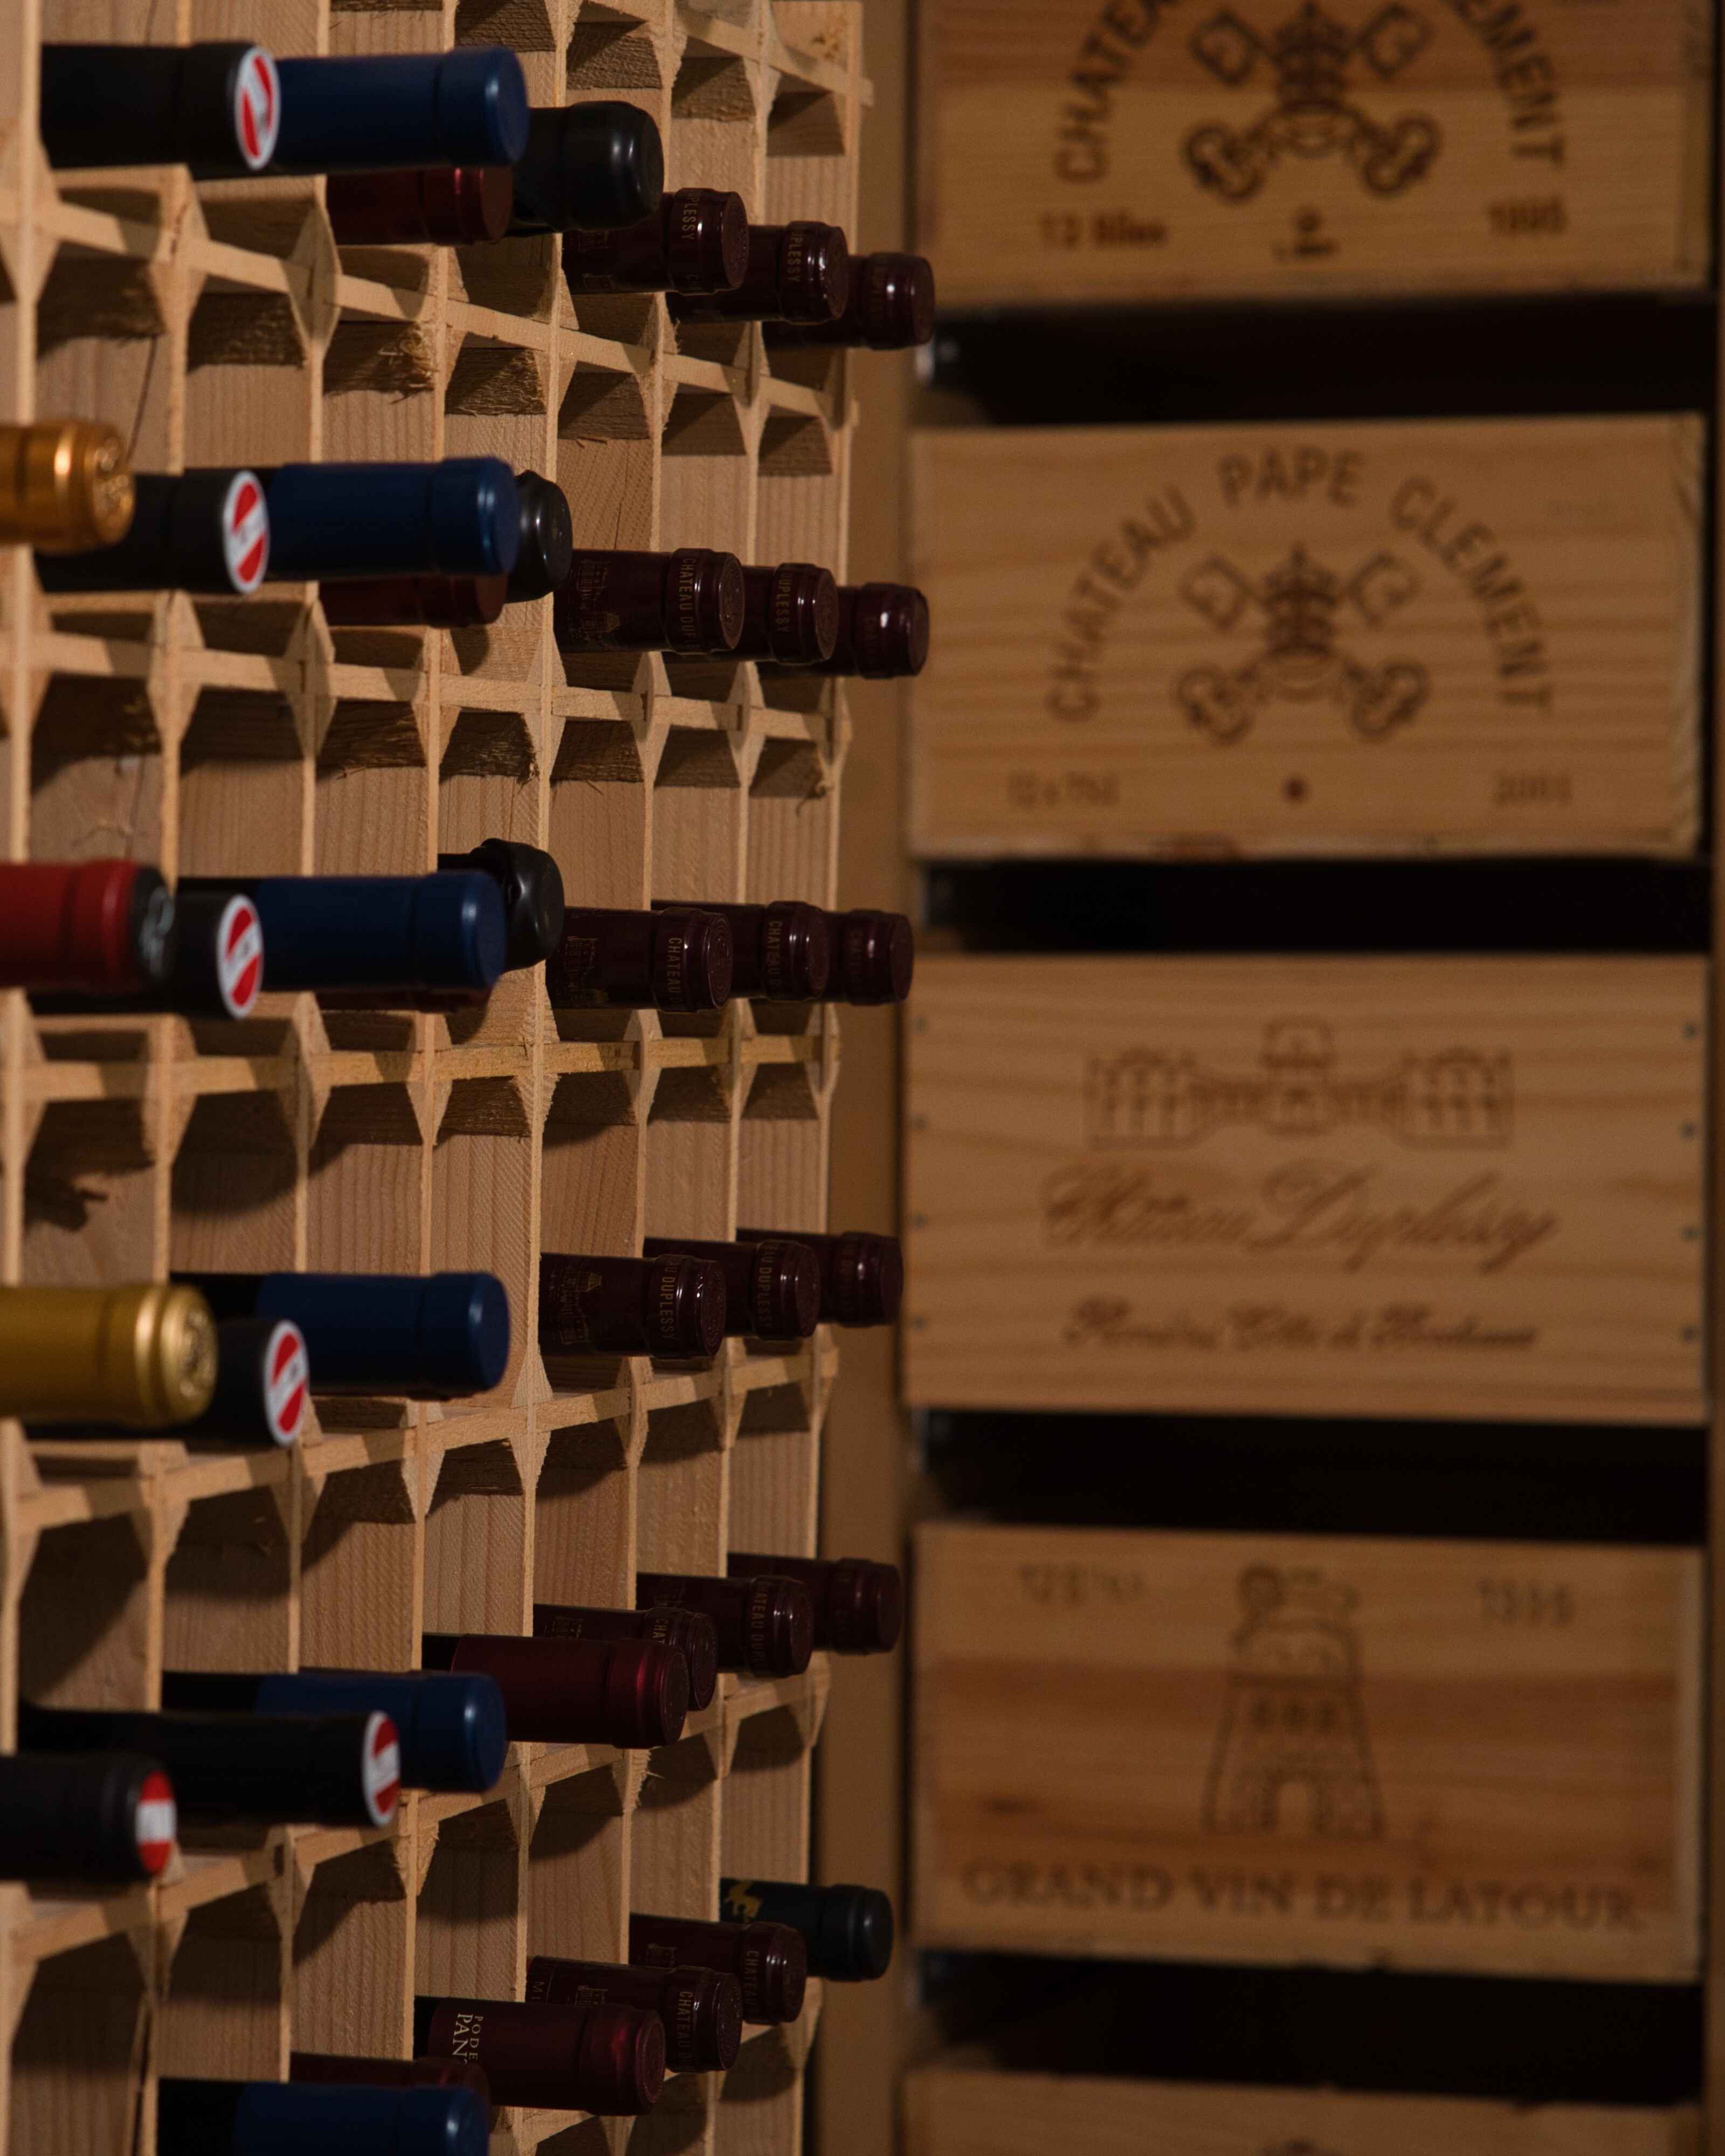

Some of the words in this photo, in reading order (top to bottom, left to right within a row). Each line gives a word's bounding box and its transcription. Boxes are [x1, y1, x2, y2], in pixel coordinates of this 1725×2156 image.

[1052, 0, 1163, 183] CHATE
[681, 190, 700, 241] UPLESSY
[678, 558, 696, 611] CHATEAU
[1044, 481, 1197, 724] CHATEAU
[1215, 443, 1365, 510] PAPE
[1388, 474, 1555, 716] CLEMENT
[666, 936, 684, 993] CHATEAU
[659, 1275, 678, 1342] DUPLESSY
[961, 1856, 1175, 1912] GRAND
[1186, 1867, 1295, 1918] VIN
[1312, 1871, 1392, 1923] DE
[1406, 1876, 1650, 1935] LATOUR
[452, 2013, 474, 2065] PAN
[677, 1991, 693, 2049] CHATEAU
